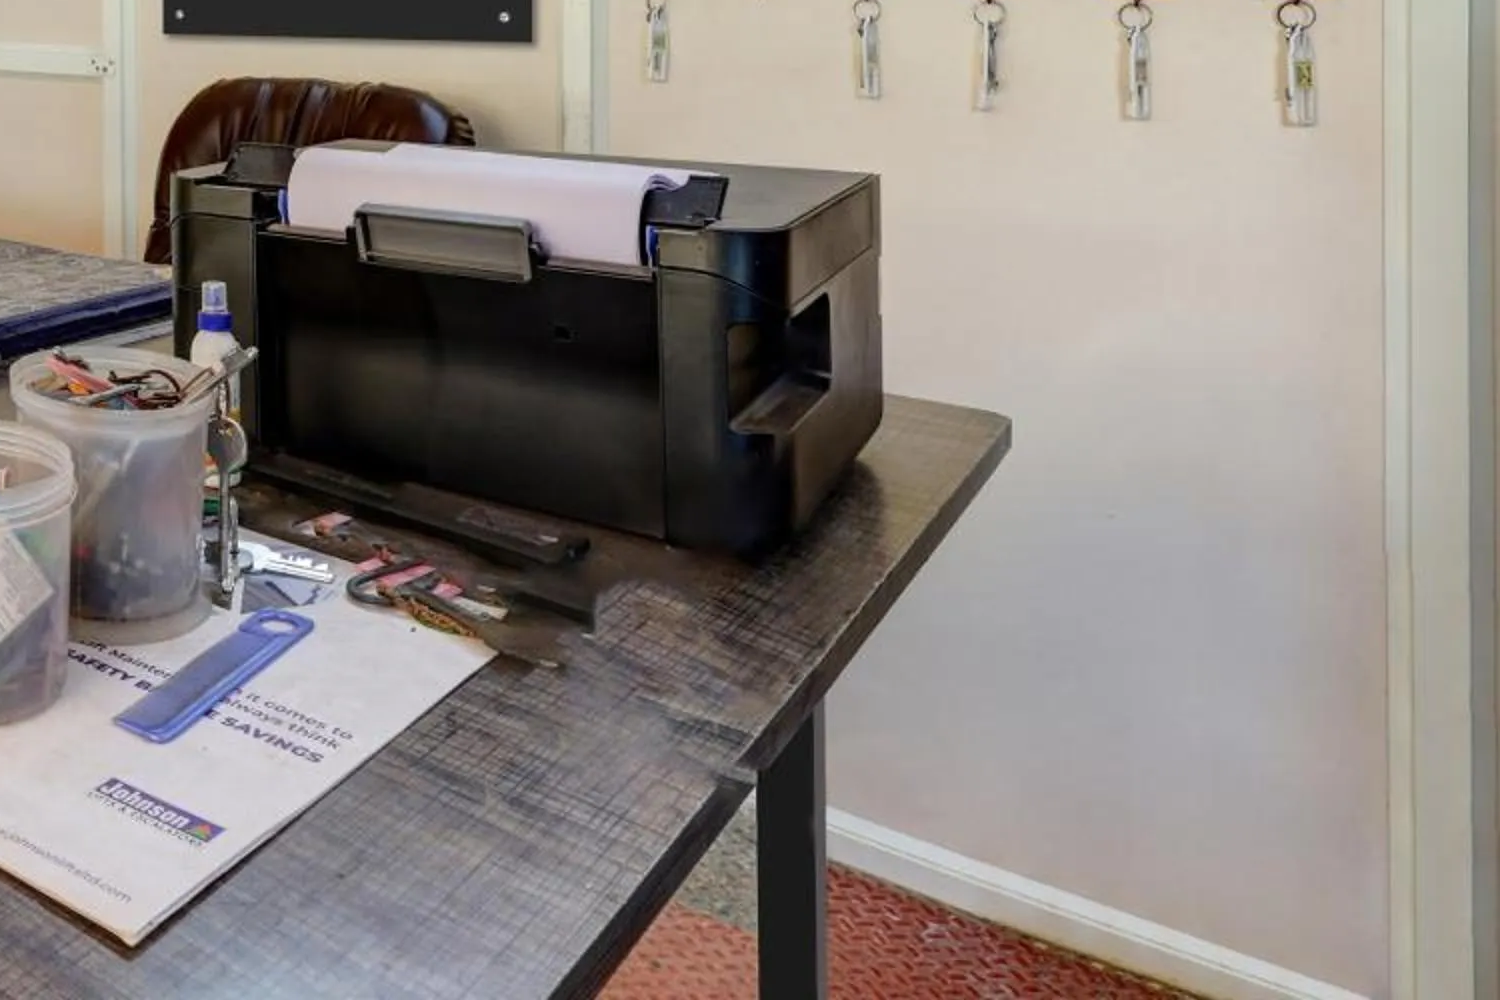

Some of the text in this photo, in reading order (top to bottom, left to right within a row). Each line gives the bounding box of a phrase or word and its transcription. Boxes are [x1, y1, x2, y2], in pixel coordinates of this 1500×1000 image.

[219, 716, 325, 764] SAVINGS
[264, 700, 328, 730] comes
[331, 726, 354, 740] to
[288, 721, 341, 751] think
[99, 783, 191, 829] Johnson
